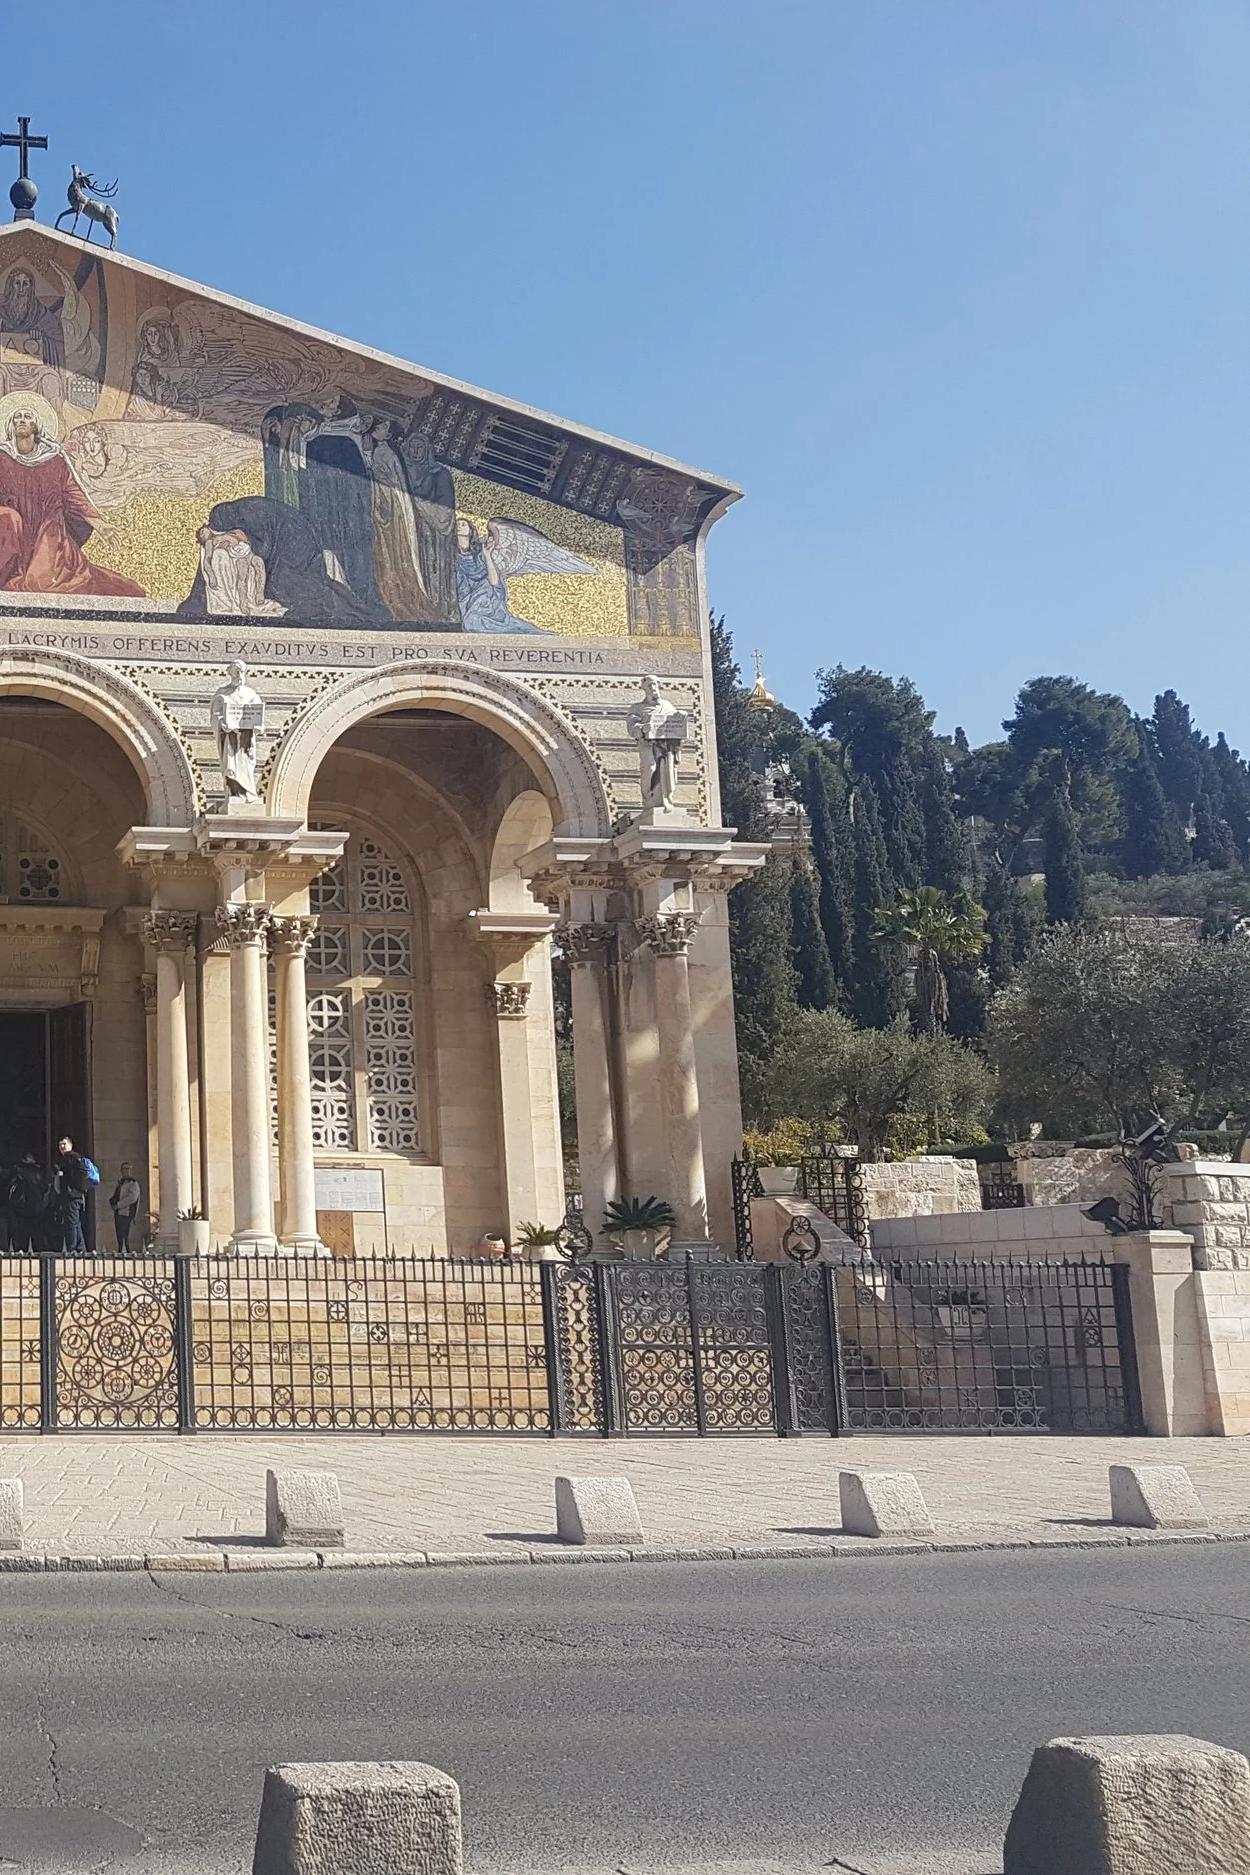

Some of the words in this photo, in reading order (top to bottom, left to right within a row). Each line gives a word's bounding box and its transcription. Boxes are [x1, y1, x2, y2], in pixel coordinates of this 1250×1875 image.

[8, 632, 100, 650] LACRYMIS
[112, 637, 212, 653] OFFERENS
[225, 641, 330, 658] EXAVDITVS
[342, 645, 377, 659] EST
[392, 646, 429, 660] PRO
[443, 648, 478, 662] SVA
[490, 649, 605, 664] REVERENTIA
